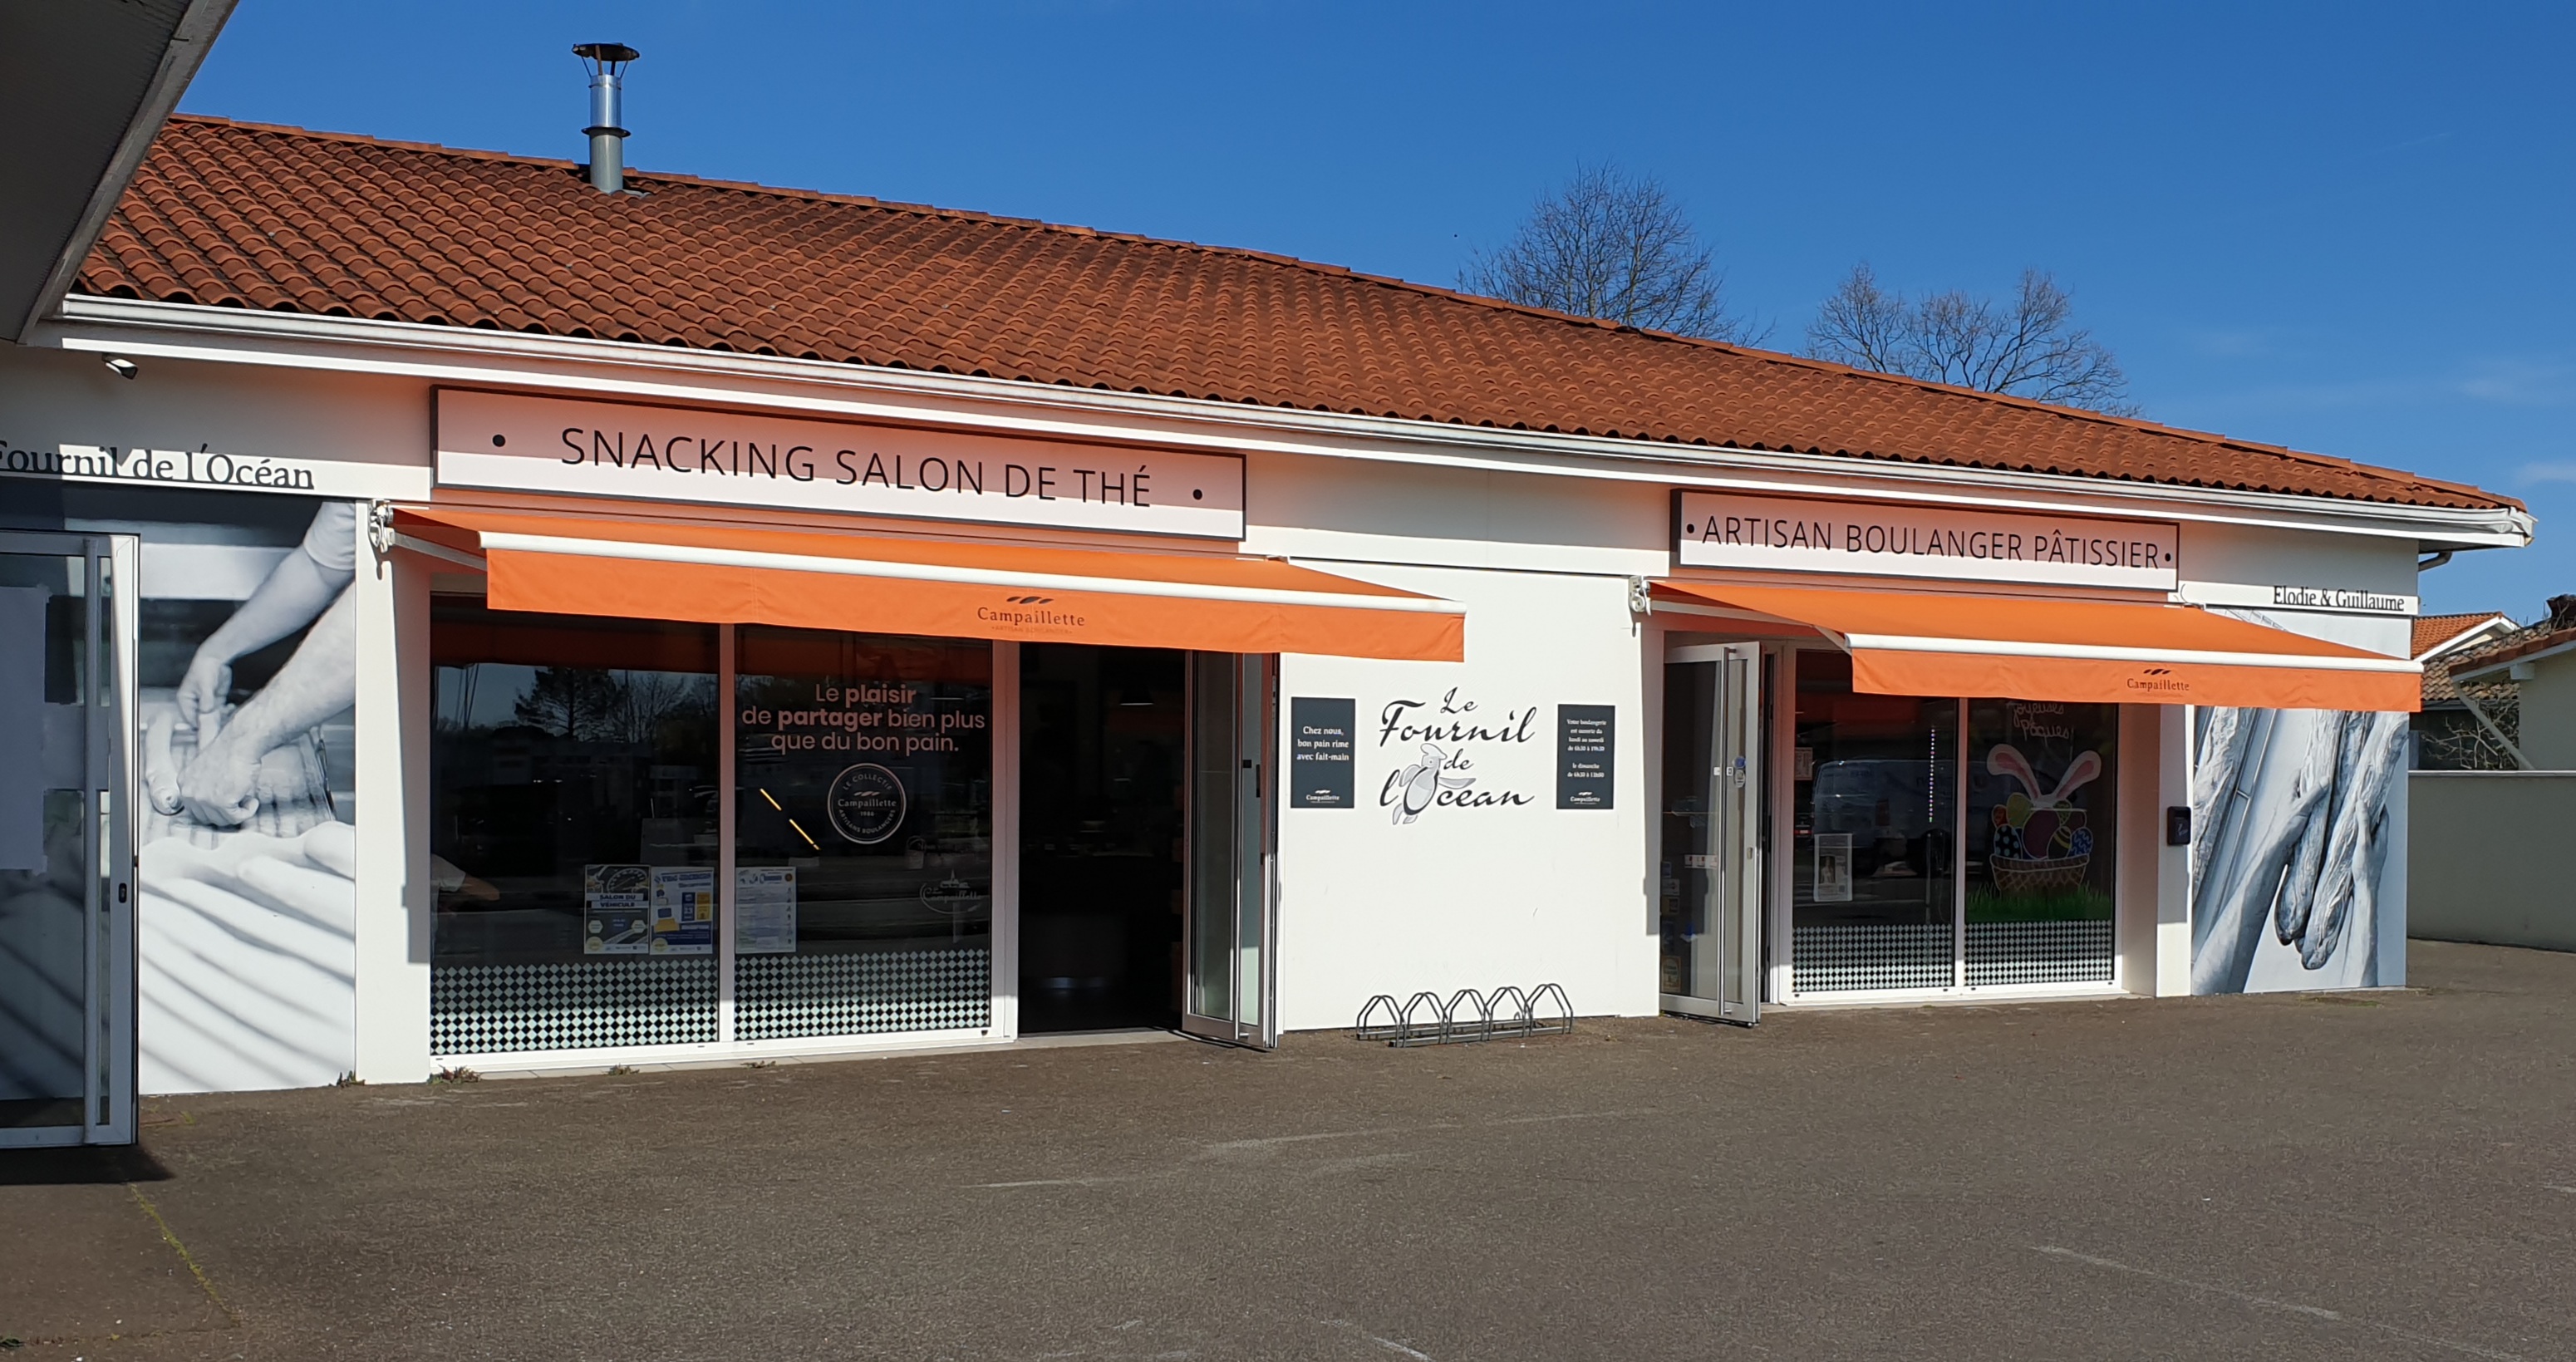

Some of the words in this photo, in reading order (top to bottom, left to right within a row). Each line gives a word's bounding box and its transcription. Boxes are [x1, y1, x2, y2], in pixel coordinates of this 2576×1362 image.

[133, 449, 174, 480] de
[561, 427, 814, 482] SNACKING
[835, 449, 983, 496] SALON
[1005, 464, 1056, 501] DE
[1073, 465, 1151, 508] THÉ
[1702, 515, 1831, 550] ARTISAN
[1846, 524, 2022, 561] BOULANGER
[2035, 529, 2159, 569] PÂTISSIER
[2273, 585, 2317, 606] Elodie
[2320, 588, 2332, 607] &
[2336, 589, 2405, 612] Guillaume
[977, 607, 1085, 626] Campaillette
[815, 684, 839, 702] Le
[845, 684, 917, 707] plaisir
[2126, 678, 2190, 691] Campaillette
[1439, 686, 1479, 714] Le
[742, 706, 771, 725] de
[779, 707, 882, 732] partager
[888, 709, 935, 727] bien
[941, 711, 986, 733] plus
[1379, 700, 1537, 748] Fournil
[771, 735, 816, 755] que
[821, 732, 851, 750] du
[857, 732, 899, 751] bon
[906, 733, 959, 756] pain.
[1297, 739, 1312, 747] bon
[1314, 740, 1330, 749] pain
[1332, 740, 1349, 748] rime
[1315, 752, 1349, 760] fait-main
[1443, 748, 1475, 770] de
[843, 780, 852, 790] LE
[853, 773, 892, 790] COLLECTIF
[838, 799, 897, 809] Campaillette
